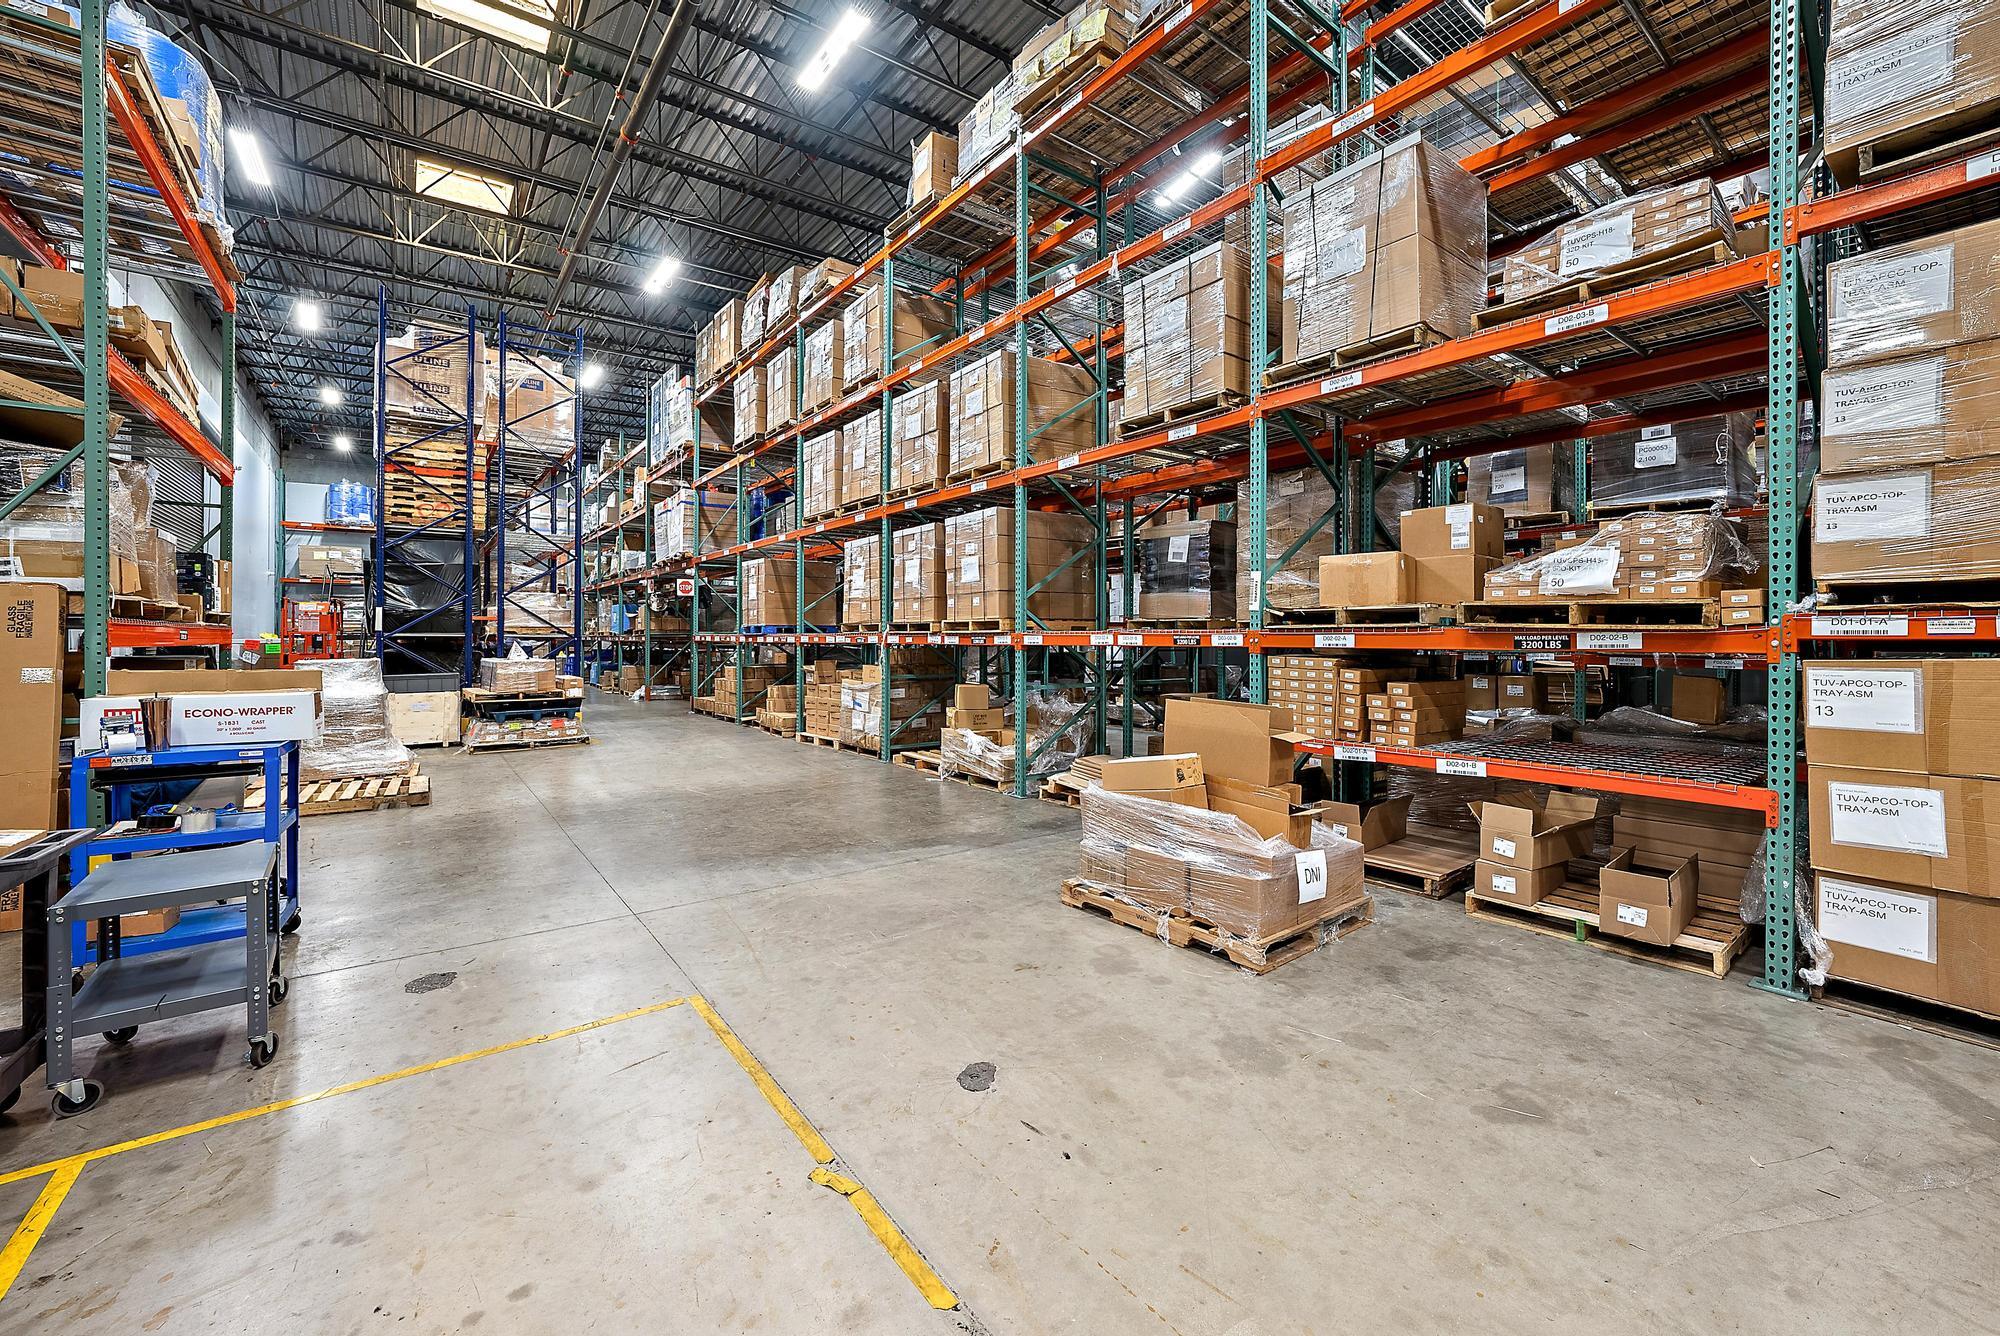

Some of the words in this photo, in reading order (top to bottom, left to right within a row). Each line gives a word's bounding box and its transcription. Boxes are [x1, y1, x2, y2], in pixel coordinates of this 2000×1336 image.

[1835, 59, 1902, 91] TRAY-ASM
[1565, 227, 1615, 248] TUVCPS-H18-
[1565, 257, 1579, 268] 50
[1557, 309, 1595, 324] D02-03-B
[1835, 415, 1846, 423] 13
[1826, 491, 1906, 504] TUV-APCO-TOP-
[1826, 504, 1877, 515] TRAY-ASM
[1551, 578, 1564, 587] 50
[7, 606, 17, 633] GLASS
[16, 600, 26, 638] FRAGILE
[1831, 617, 1888, 626] D01-01-A
[1521, 641, 1543, 649] 3200
[1813, 679, 1907, 688] TUV-APCO-TOP-
[1813, 689, 1873, 698] TRAY-ASM
[1815, 705, 1834, 716] 13
[1342, 746, 1368, 754] D02-01-A
[1446, 760, 1477, 768] D02-01-B
[1836, 793, 1933, 808] TUV-APCO-TOP-
[1836, 804, 1899, 816] TRAY-ASM
[1304, 866, 1321, 884] DNI
[1825, 891, 1922, 914] TUV-APCO-TOP-
[1825, 901, 1887, 919] TRAY-ASM
